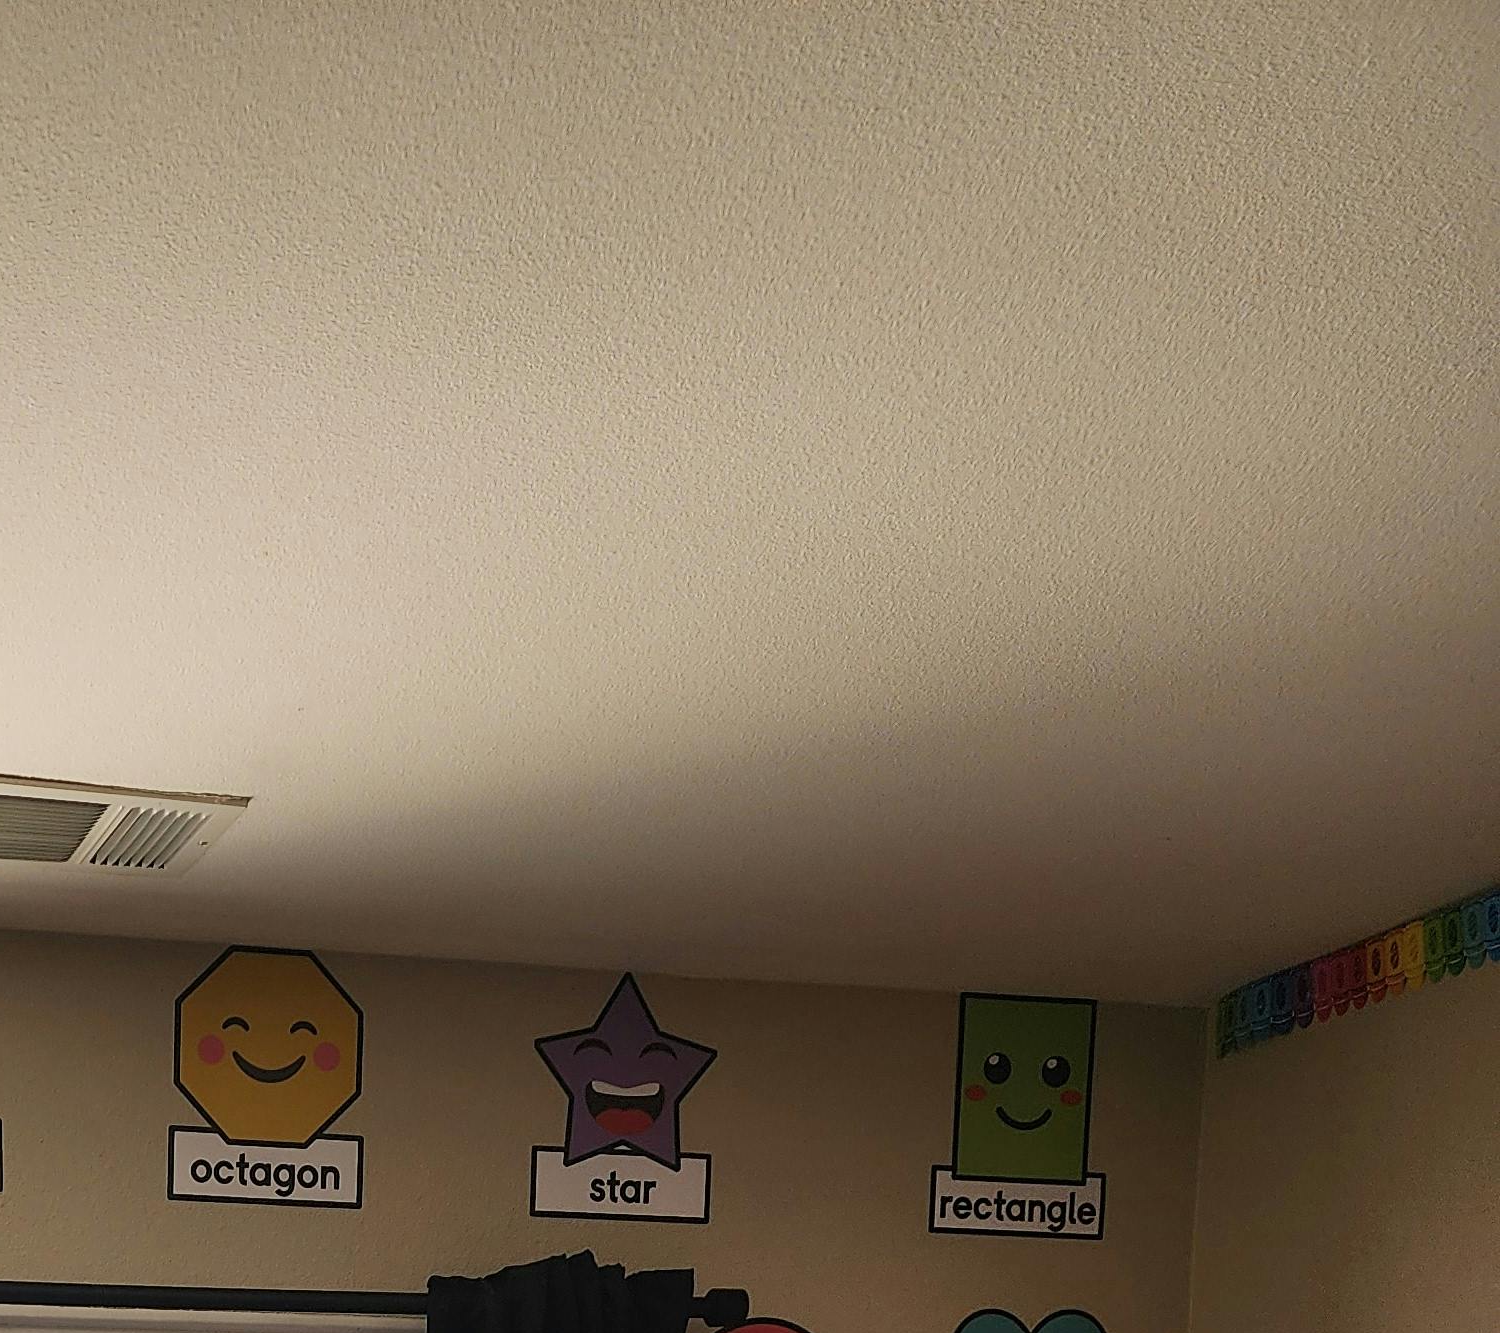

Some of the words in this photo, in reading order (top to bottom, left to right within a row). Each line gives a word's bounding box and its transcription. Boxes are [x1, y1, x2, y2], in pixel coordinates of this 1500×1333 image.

[190, 1150, 341, 1197] octagon
[589, 1173, 657, 1206] star
[938, 1190, 1097, 1232] rectangle
